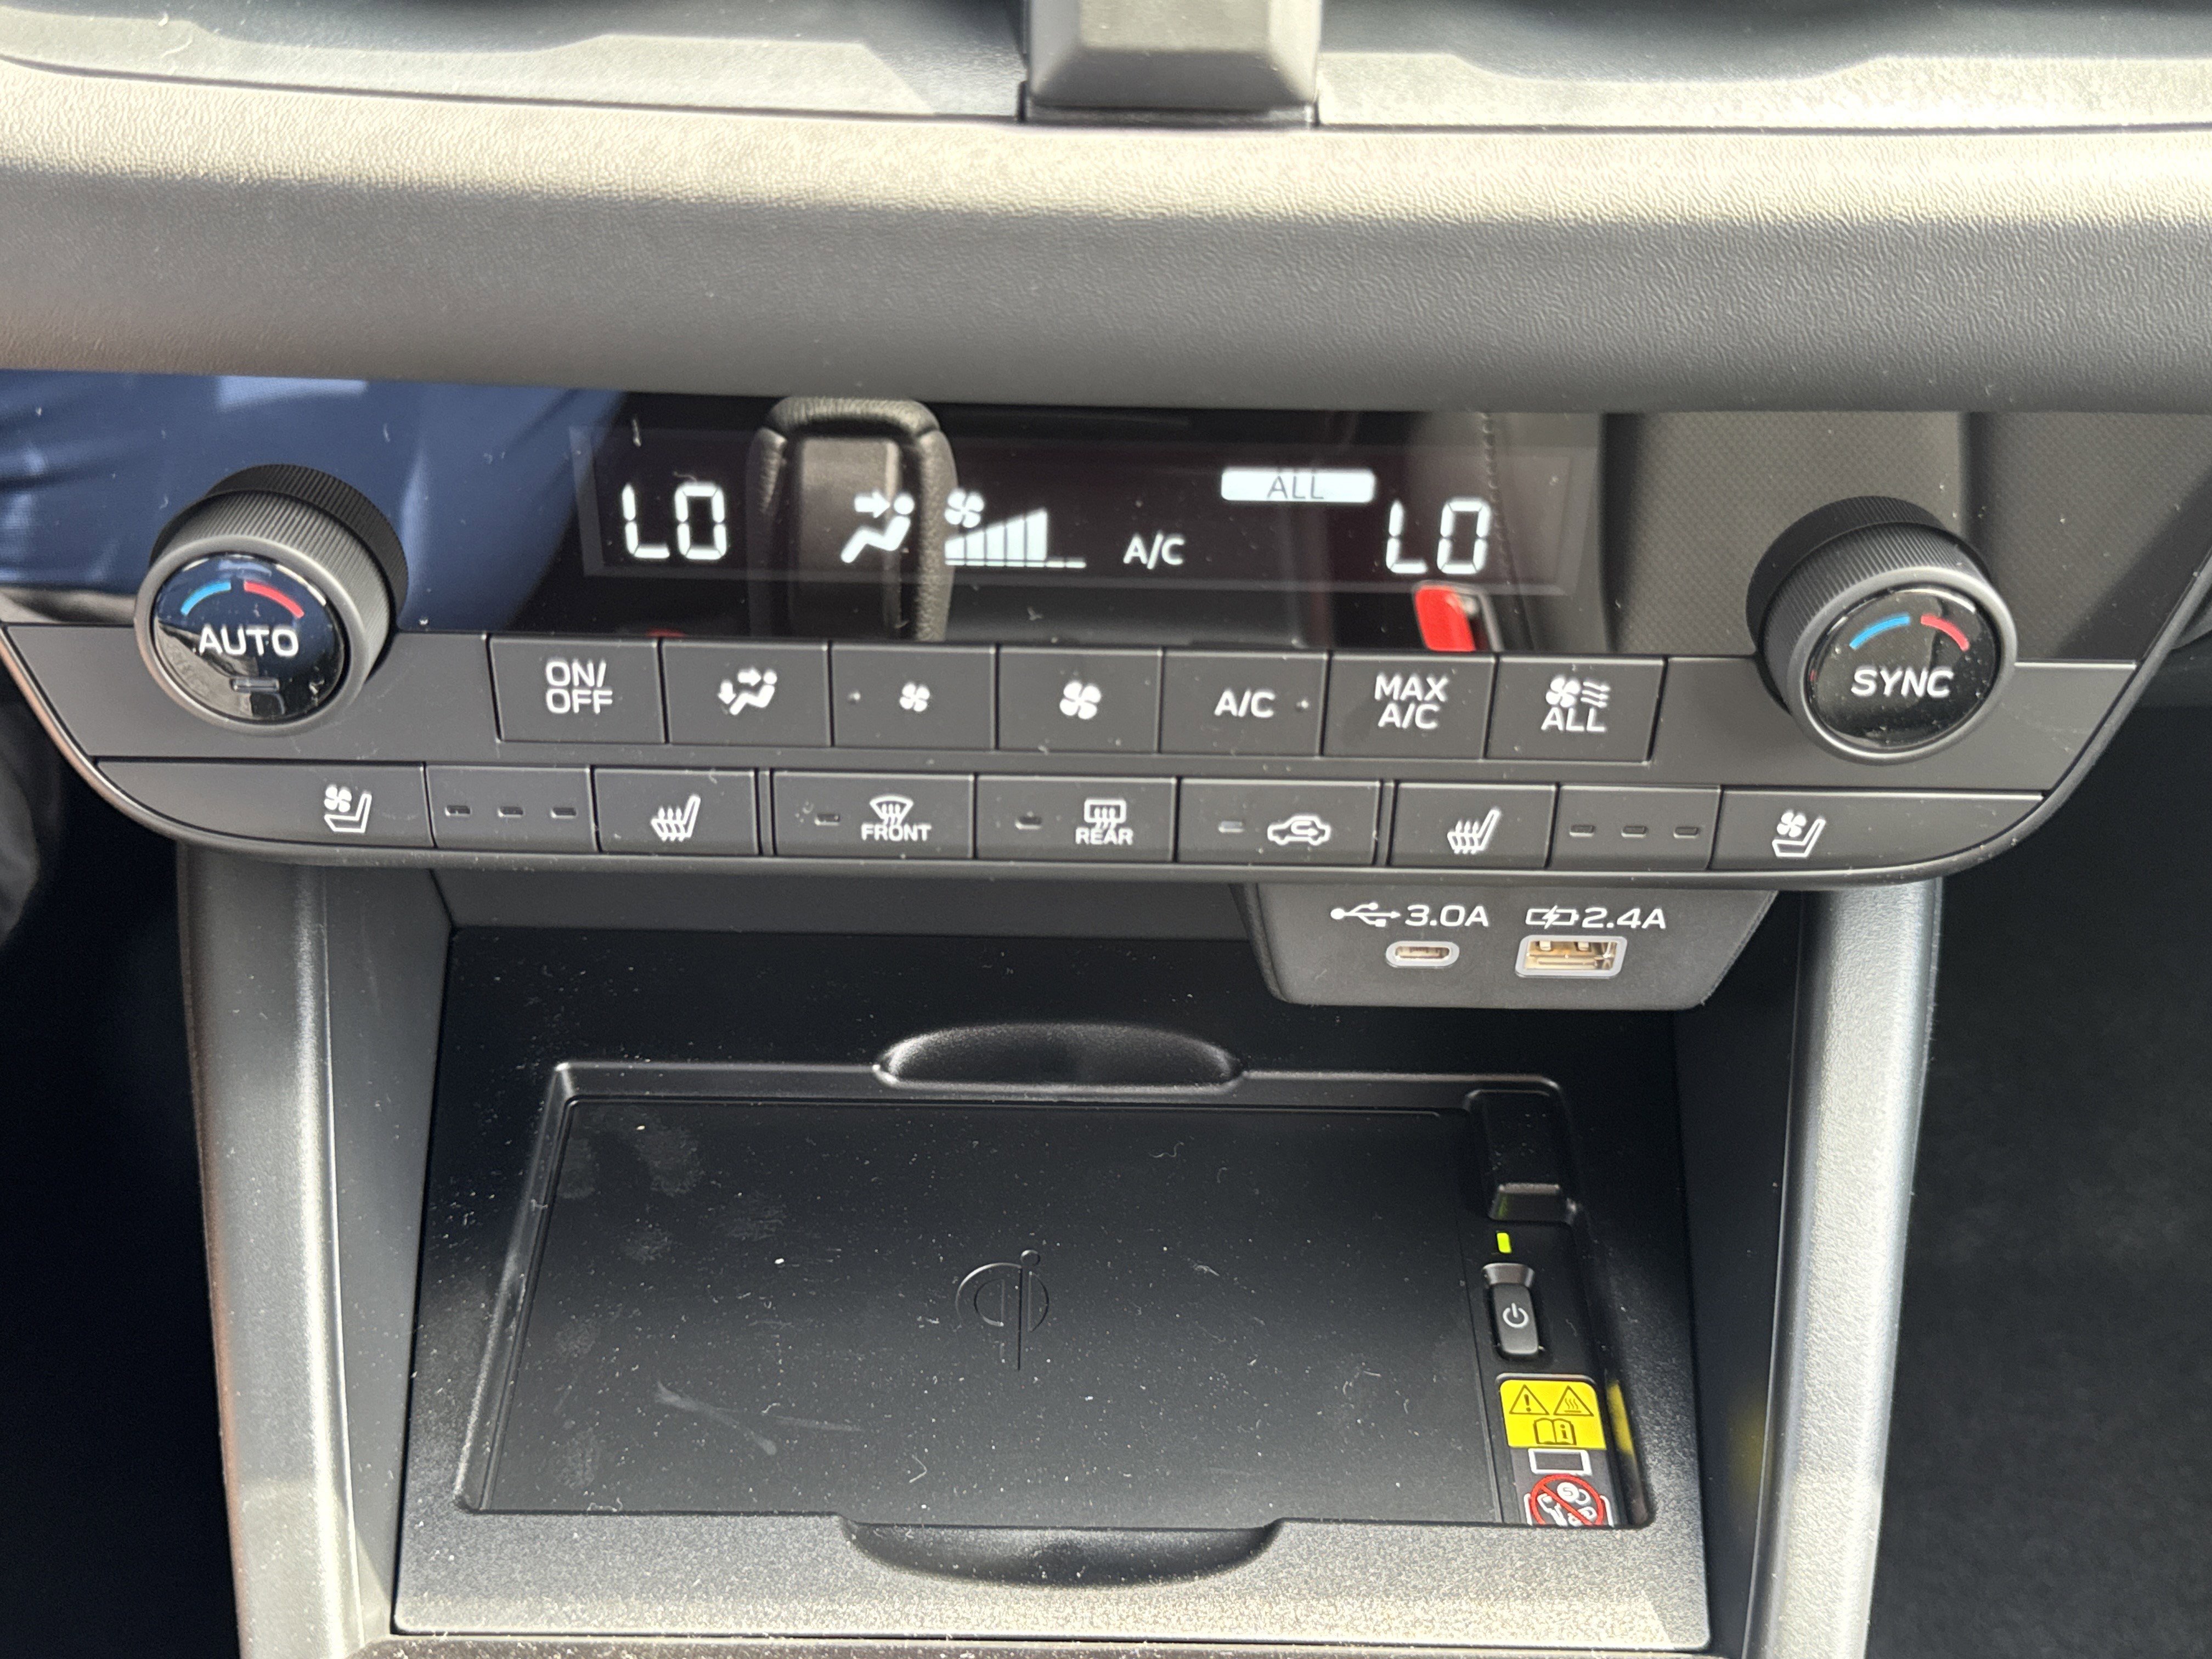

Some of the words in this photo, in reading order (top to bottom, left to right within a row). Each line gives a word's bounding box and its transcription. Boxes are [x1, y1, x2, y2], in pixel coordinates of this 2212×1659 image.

[1267, 474, 1324, 500] ALL
[621, 482, 728, 561] LO
[1386, 496, 1491, 574] LO
[1123, 531, 1186, 569] A/C
[198, 624, 300, 658] AUTO
[545, 659, 607, 688] ON/
[1374, 673, 1449, 702] MAX
[1850, 667, 1954, 698] SYNC
[545, 687, 613, 715] OFF
[1214, 689, 1276, 719] A/C
[1378, 702, 1441, 730] A/C
[1541, 708, 1608, 733] ALL
[860, 824, 932, 842] FRONT
[1075, 827, 1133, 846] REAR
[1404, 904, 1489, 927] 3.0A
[1581, 908, 1667, 929] 2.4A
